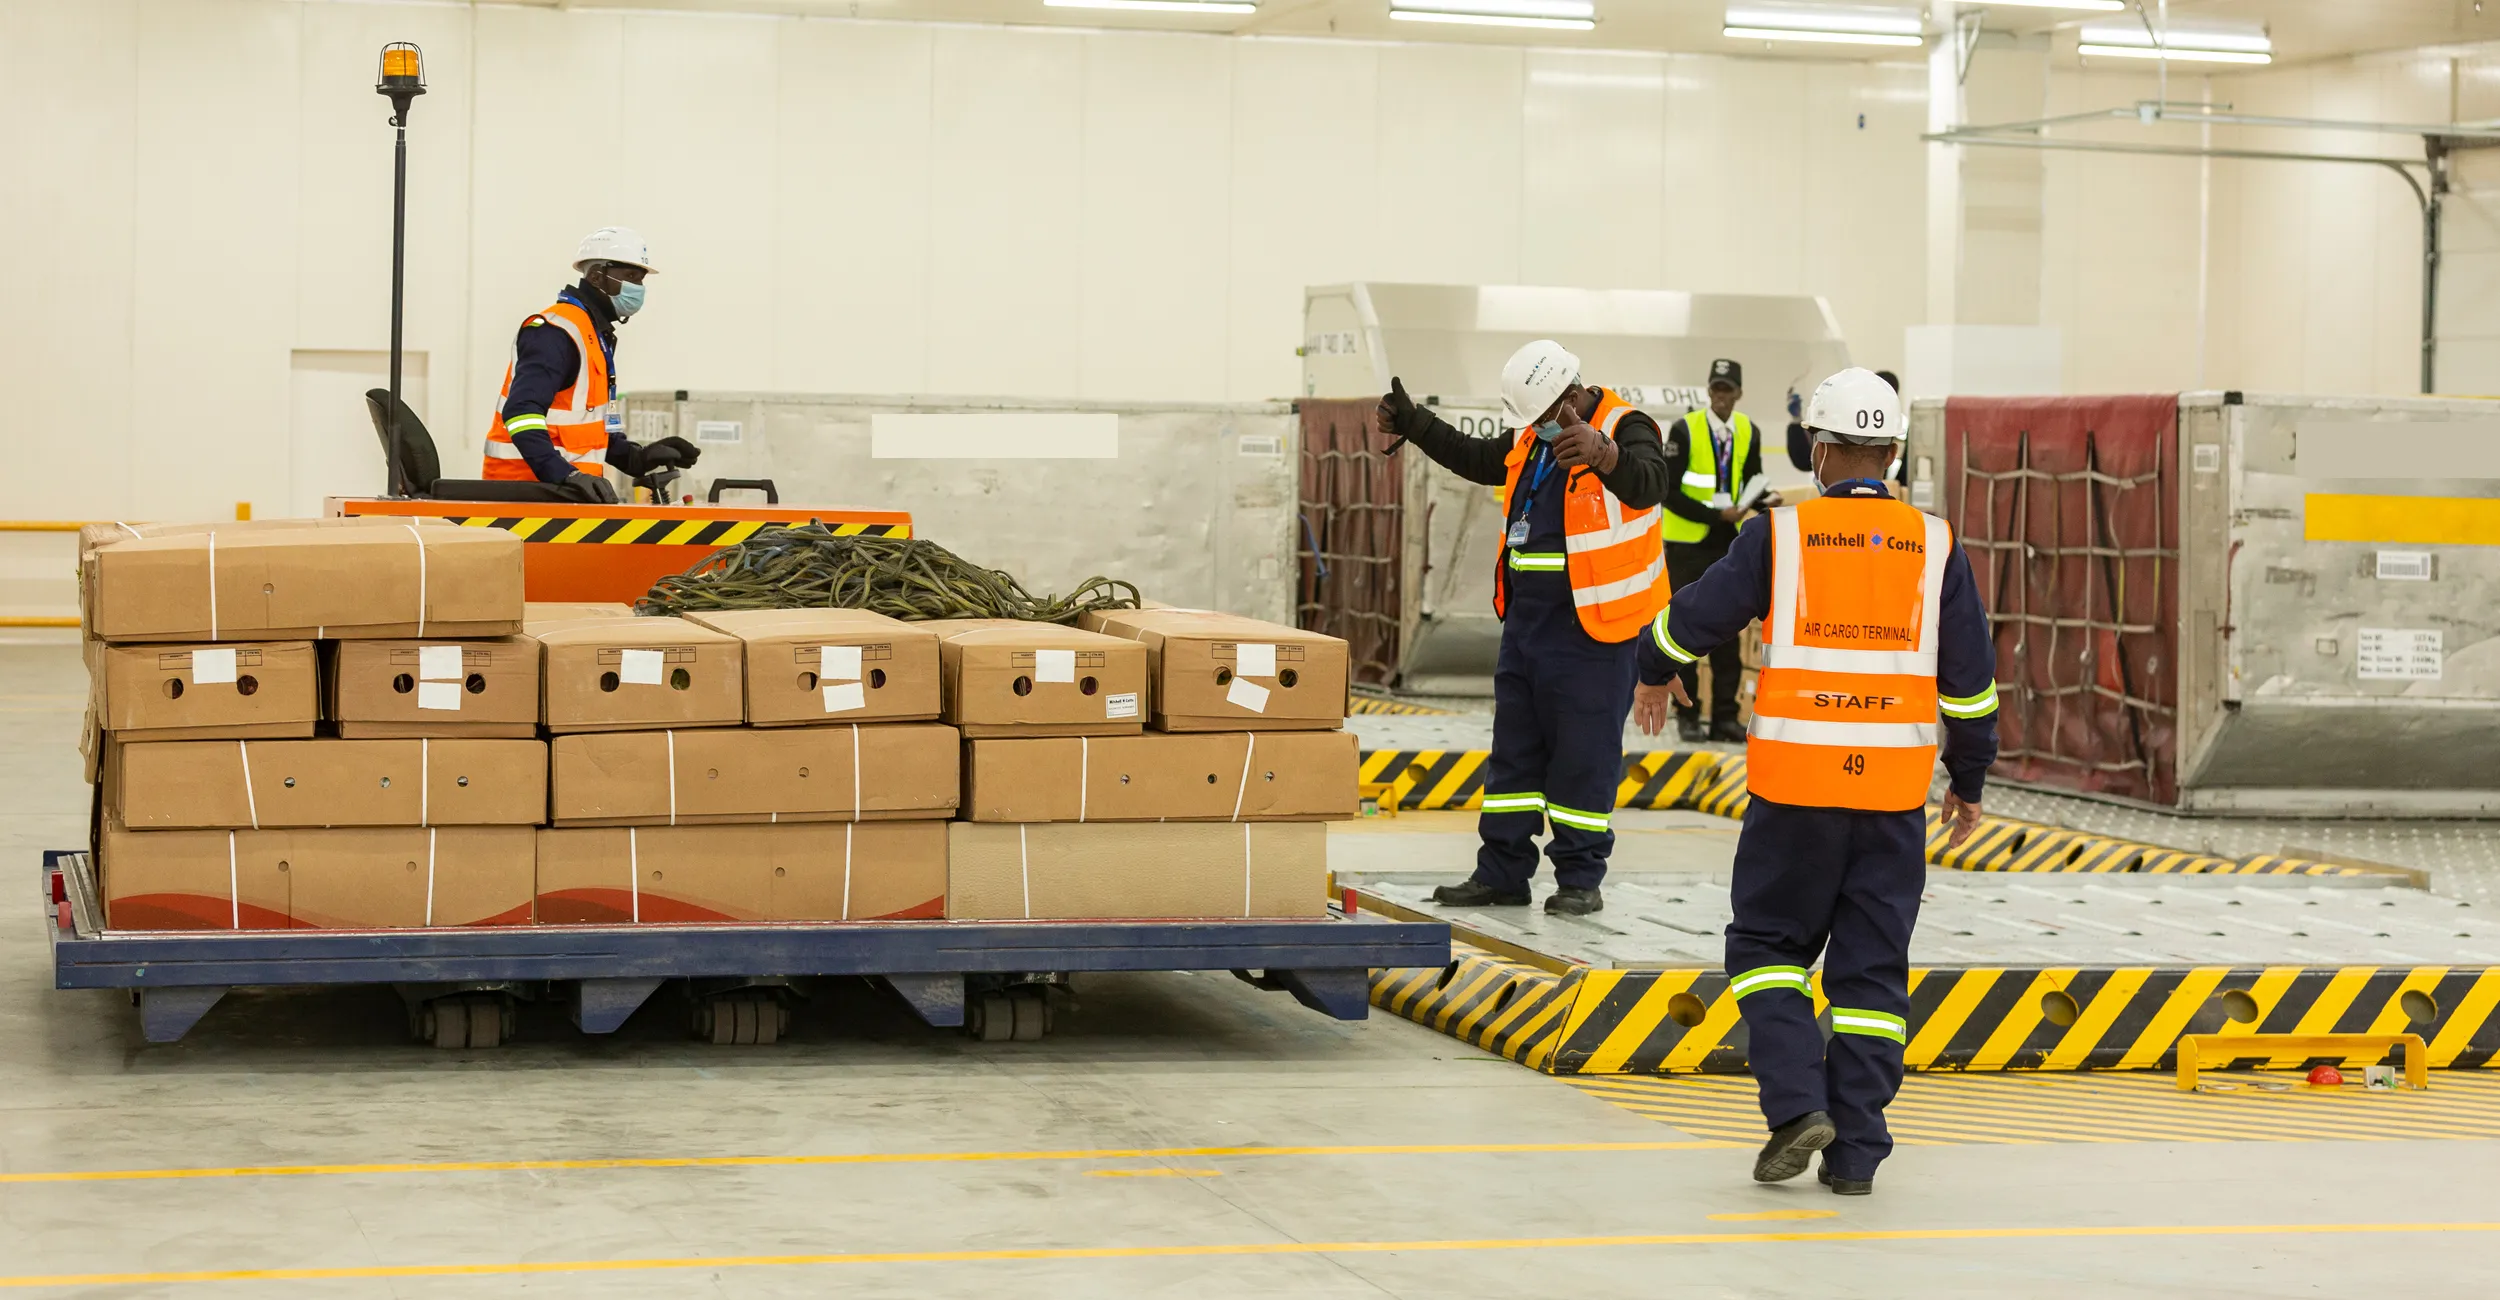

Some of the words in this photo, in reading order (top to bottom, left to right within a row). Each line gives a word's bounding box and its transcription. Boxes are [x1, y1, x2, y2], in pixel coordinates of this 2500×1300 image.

[1662, 387, 1707, 406] DHL
[1856, 409, 1885, 429] 09
[1807, 532, 1865, 548] Mitchell
[1887, 536, 1924, 554] Cotts
[1804, 622, 1821, 637] AIR
[1824, 623, 1860, 639] CARGO
[1862, 625, 1912, 642] TERMINAL
[1814, 693, 1895, 710] STAFF
[1842, 753, 1865, 776] 49
